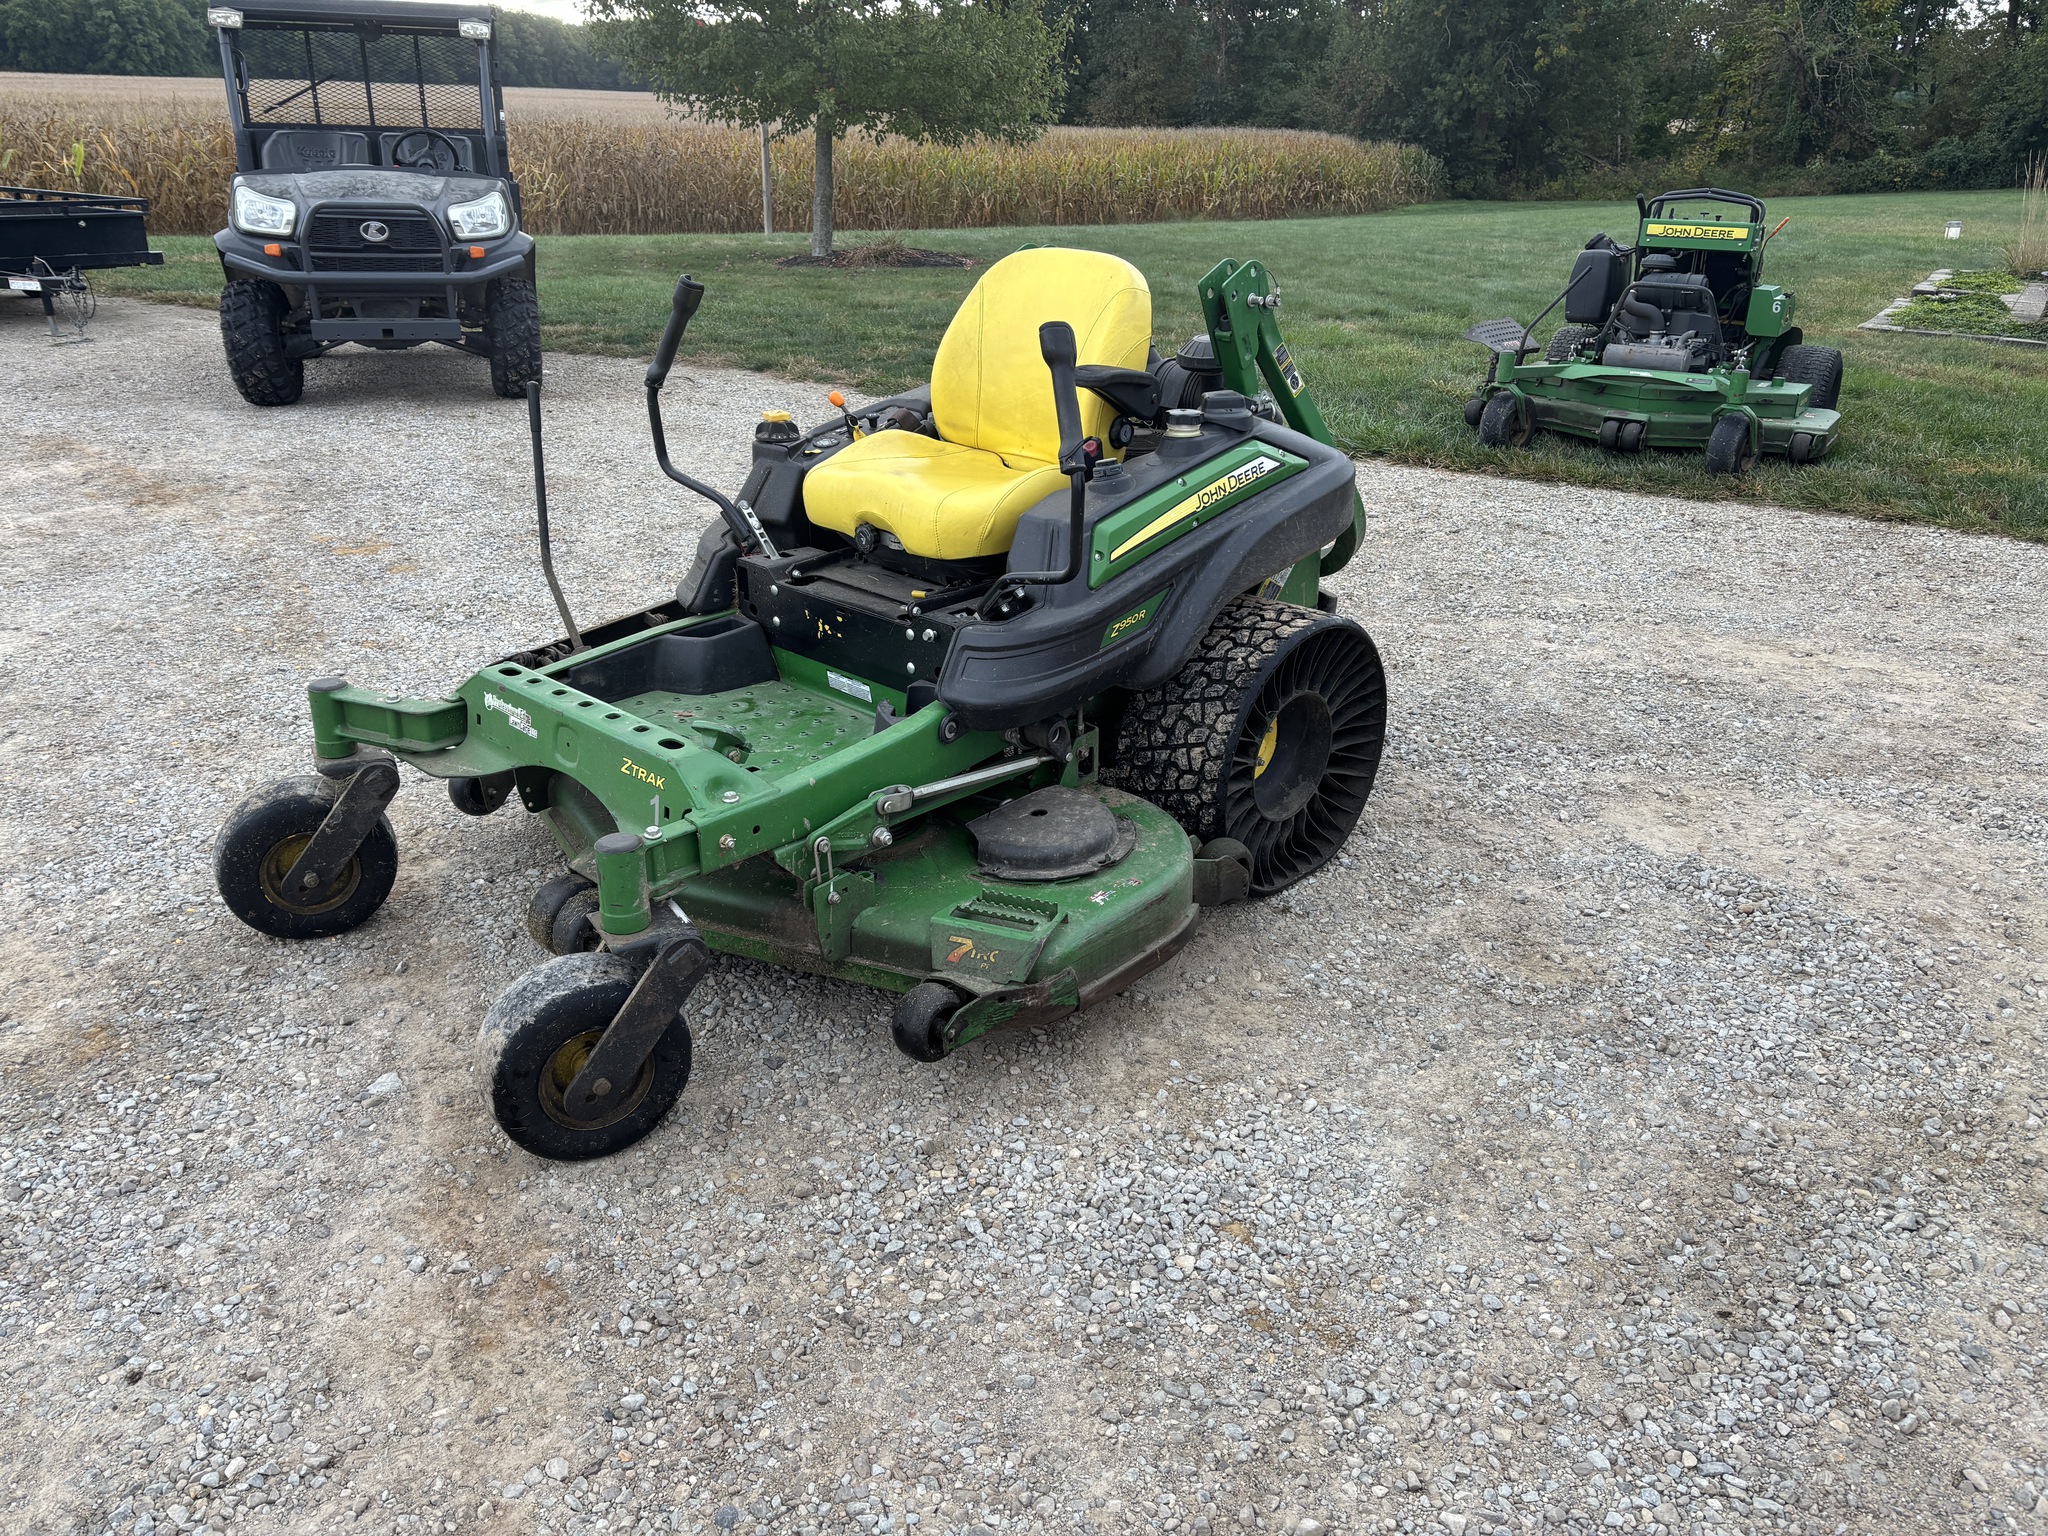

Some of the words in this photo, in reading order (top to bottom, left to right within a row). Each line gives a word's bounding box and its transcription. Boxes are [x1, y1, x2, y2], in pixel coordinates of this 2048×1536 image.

[1658, 225, 1692, 236] JOHN
[1694, 227, 1735, 239] DEERE
[1772, 301, 1781, 313] 6
[1196, 482, 1227, 510] JOHN
[1227, 462, 1266, 491] DEERE
[1110, 609, 1146, 638] Z950R
[620, 757, 666, 790] ZTRAK
[650, 794, 660, 826] 1
